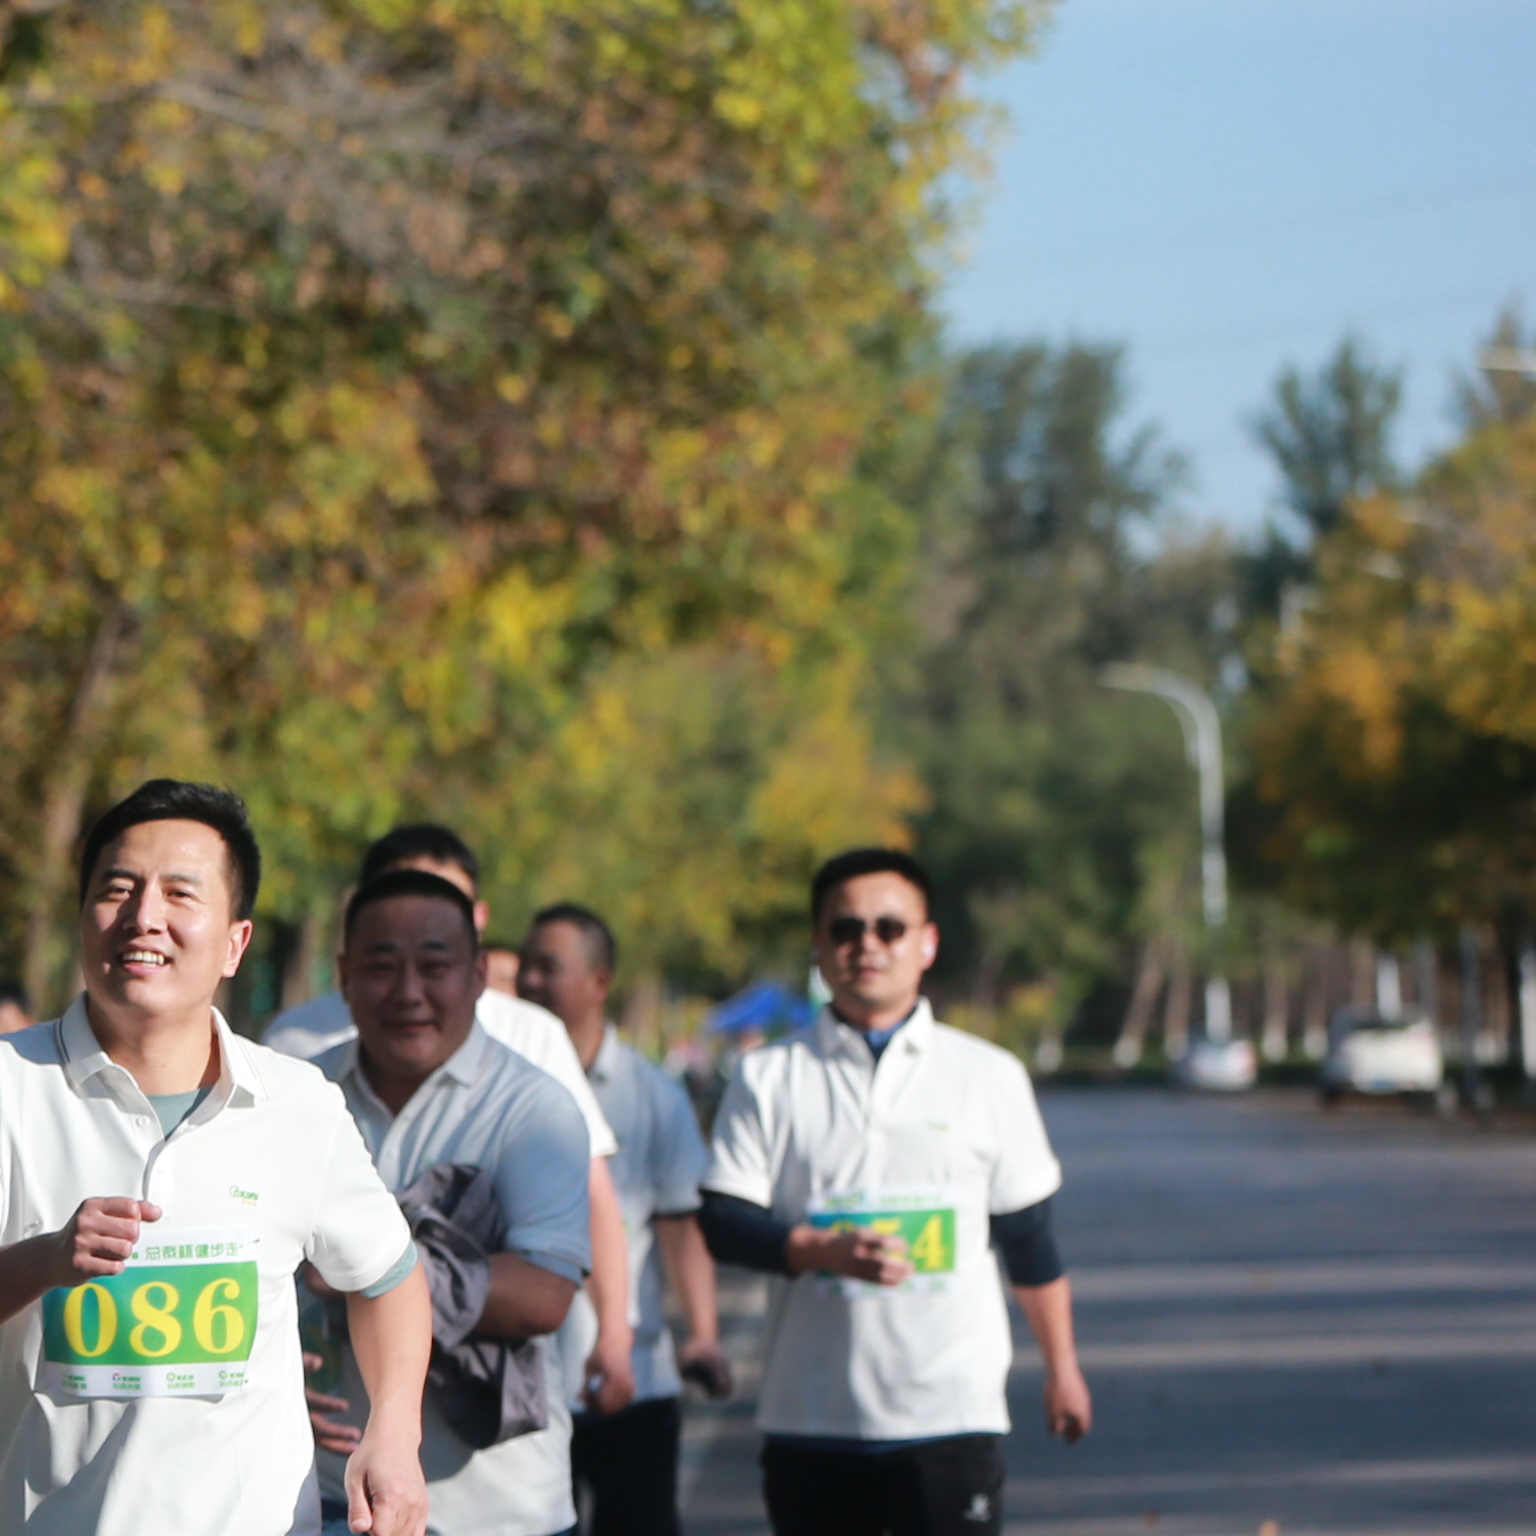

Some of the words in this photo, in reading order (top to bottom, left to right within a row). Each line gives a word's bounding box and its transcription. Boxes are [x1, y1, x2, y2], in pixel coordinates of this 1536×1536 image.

[145, 1242, 239, 1260] 总裁杯健步走
[63, 1277, 245, 1358] 086
